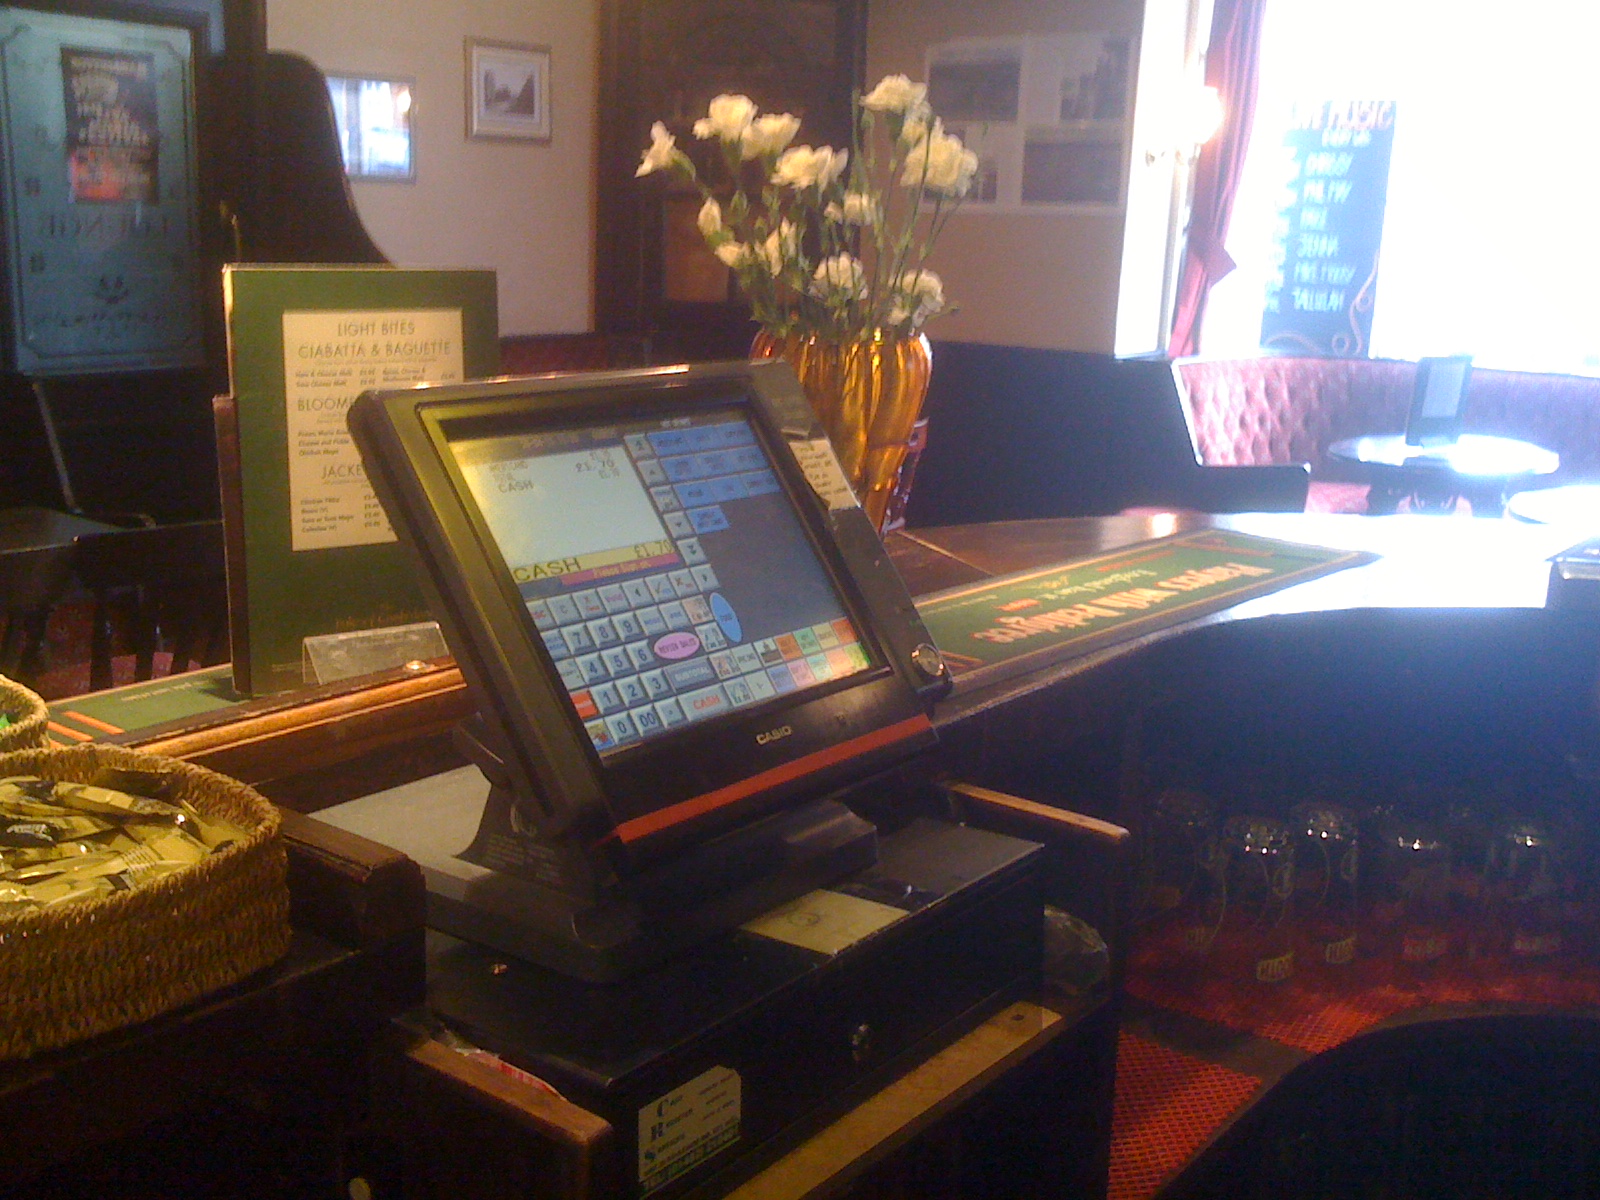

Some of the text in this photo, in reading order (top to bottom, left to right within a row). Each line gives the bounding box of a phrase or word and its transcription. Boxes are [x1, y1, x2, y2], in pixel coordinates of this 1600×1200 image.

[337, 320, 415, 337] LIGHT BITES
[298, 340, 451, 359] CIABATTA & BAGUETTE
[496, 479, 534, 493] CASH
[511, 539, 673, 581] CASH £1.70
[598, 626, 608, 638] 8
[622, 620, 633, 632] 9
[572, 632, 583, 645] 7
[612, 654, 623, 667] 5
[636, 648, 647, 661] 6
[586, 661, 598, 674] 4
[673, 666, 710, 681] SUBTOTAL
[626, 684, 638, 696] 2
[651, 677, 661, 690] 3
[601, 691, 611, 703] 1
[691, 693, 721, 710] CASH
[638, 712, 656, 727] 00
[616, 720, 627, 733] 0
[756, 725, 792, 745] CASIO
